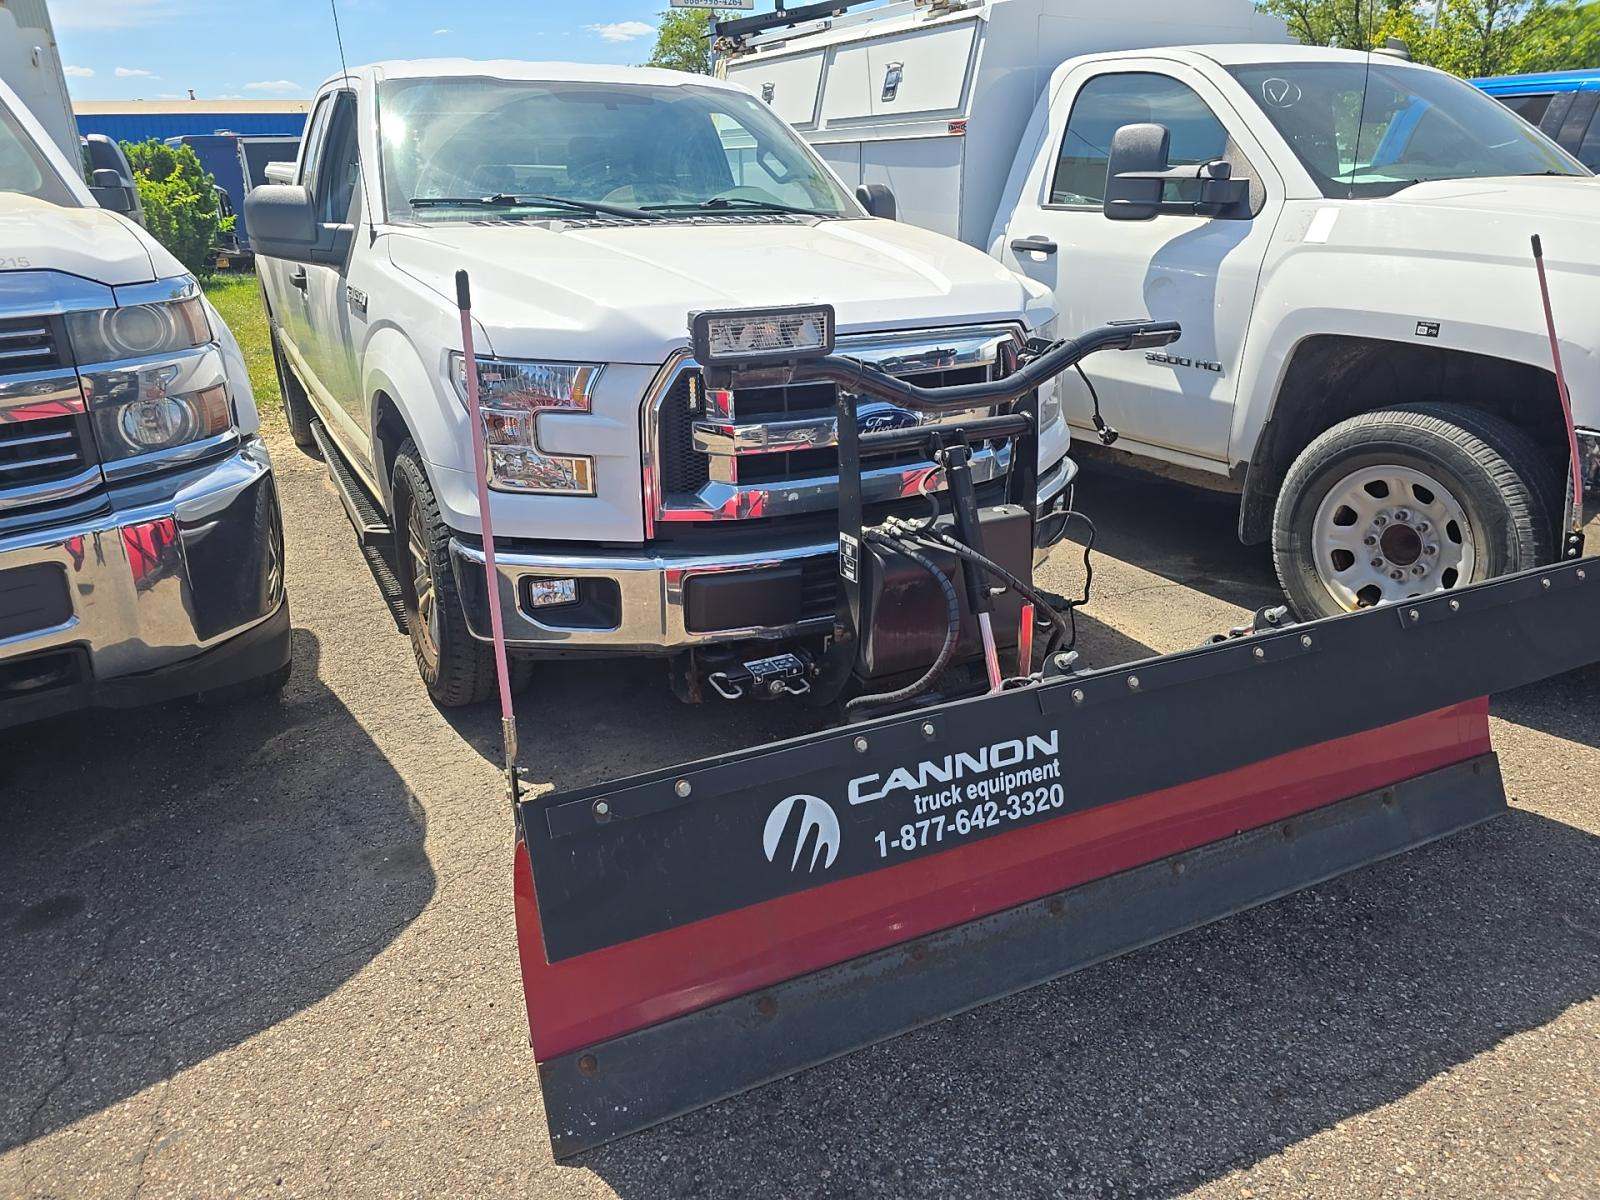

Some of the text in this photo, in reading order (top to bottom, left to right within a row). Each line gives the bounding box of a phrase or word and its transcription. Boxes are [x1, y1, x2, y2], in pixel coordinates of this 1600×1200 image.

[1145, 350, 1222, 372] 3500 HD
[848, 729, 1059, 806] CANNON
[914, 758, 1061, 815] truck equipment
[874, 783, 1065, 858] 1-877-642-3320
